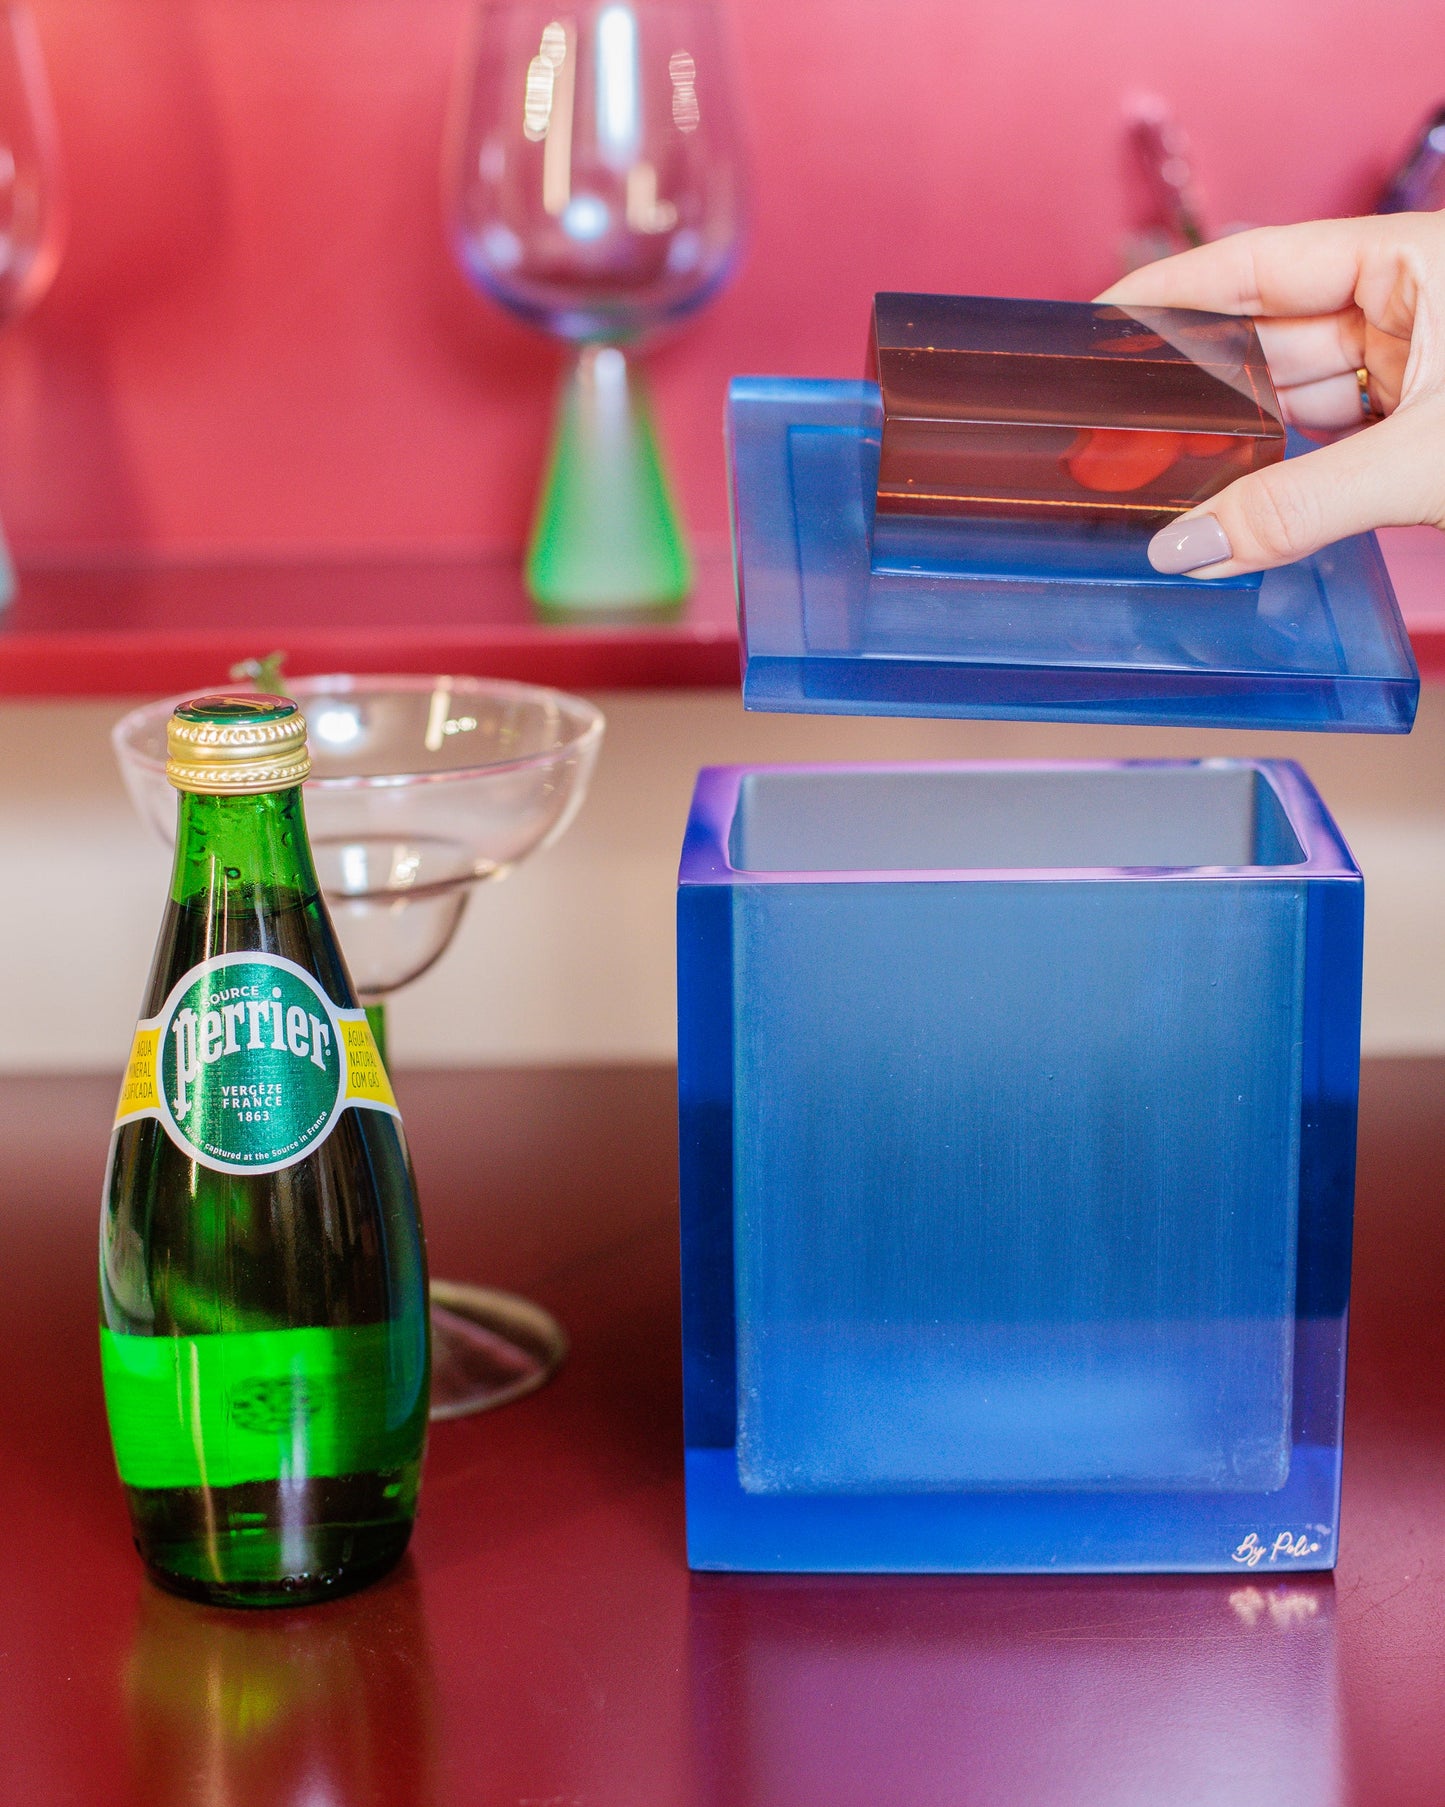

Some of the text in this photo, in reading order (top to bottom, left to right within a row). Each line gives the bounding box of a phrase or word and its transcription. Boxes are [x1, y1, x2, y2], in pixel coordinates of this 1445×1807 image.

[202, 985, 260, 1008] SOURCE
[351, 1071, 368, 1089] COM
[222, 1095, 283, 1109] FRANCE
[237, 1110, 270, 1122] 1863
[204, 1143, 241, 1160] captured
[243, 1152, 252, 1161] at
[255, 1151, 270, 1160] the
[271, 1140, 300, 1157] Source
[299, 1134, 308, 1143] in
[306, 1110, 328, 1136] France
[1231, 1532, 1267, 1567] By
